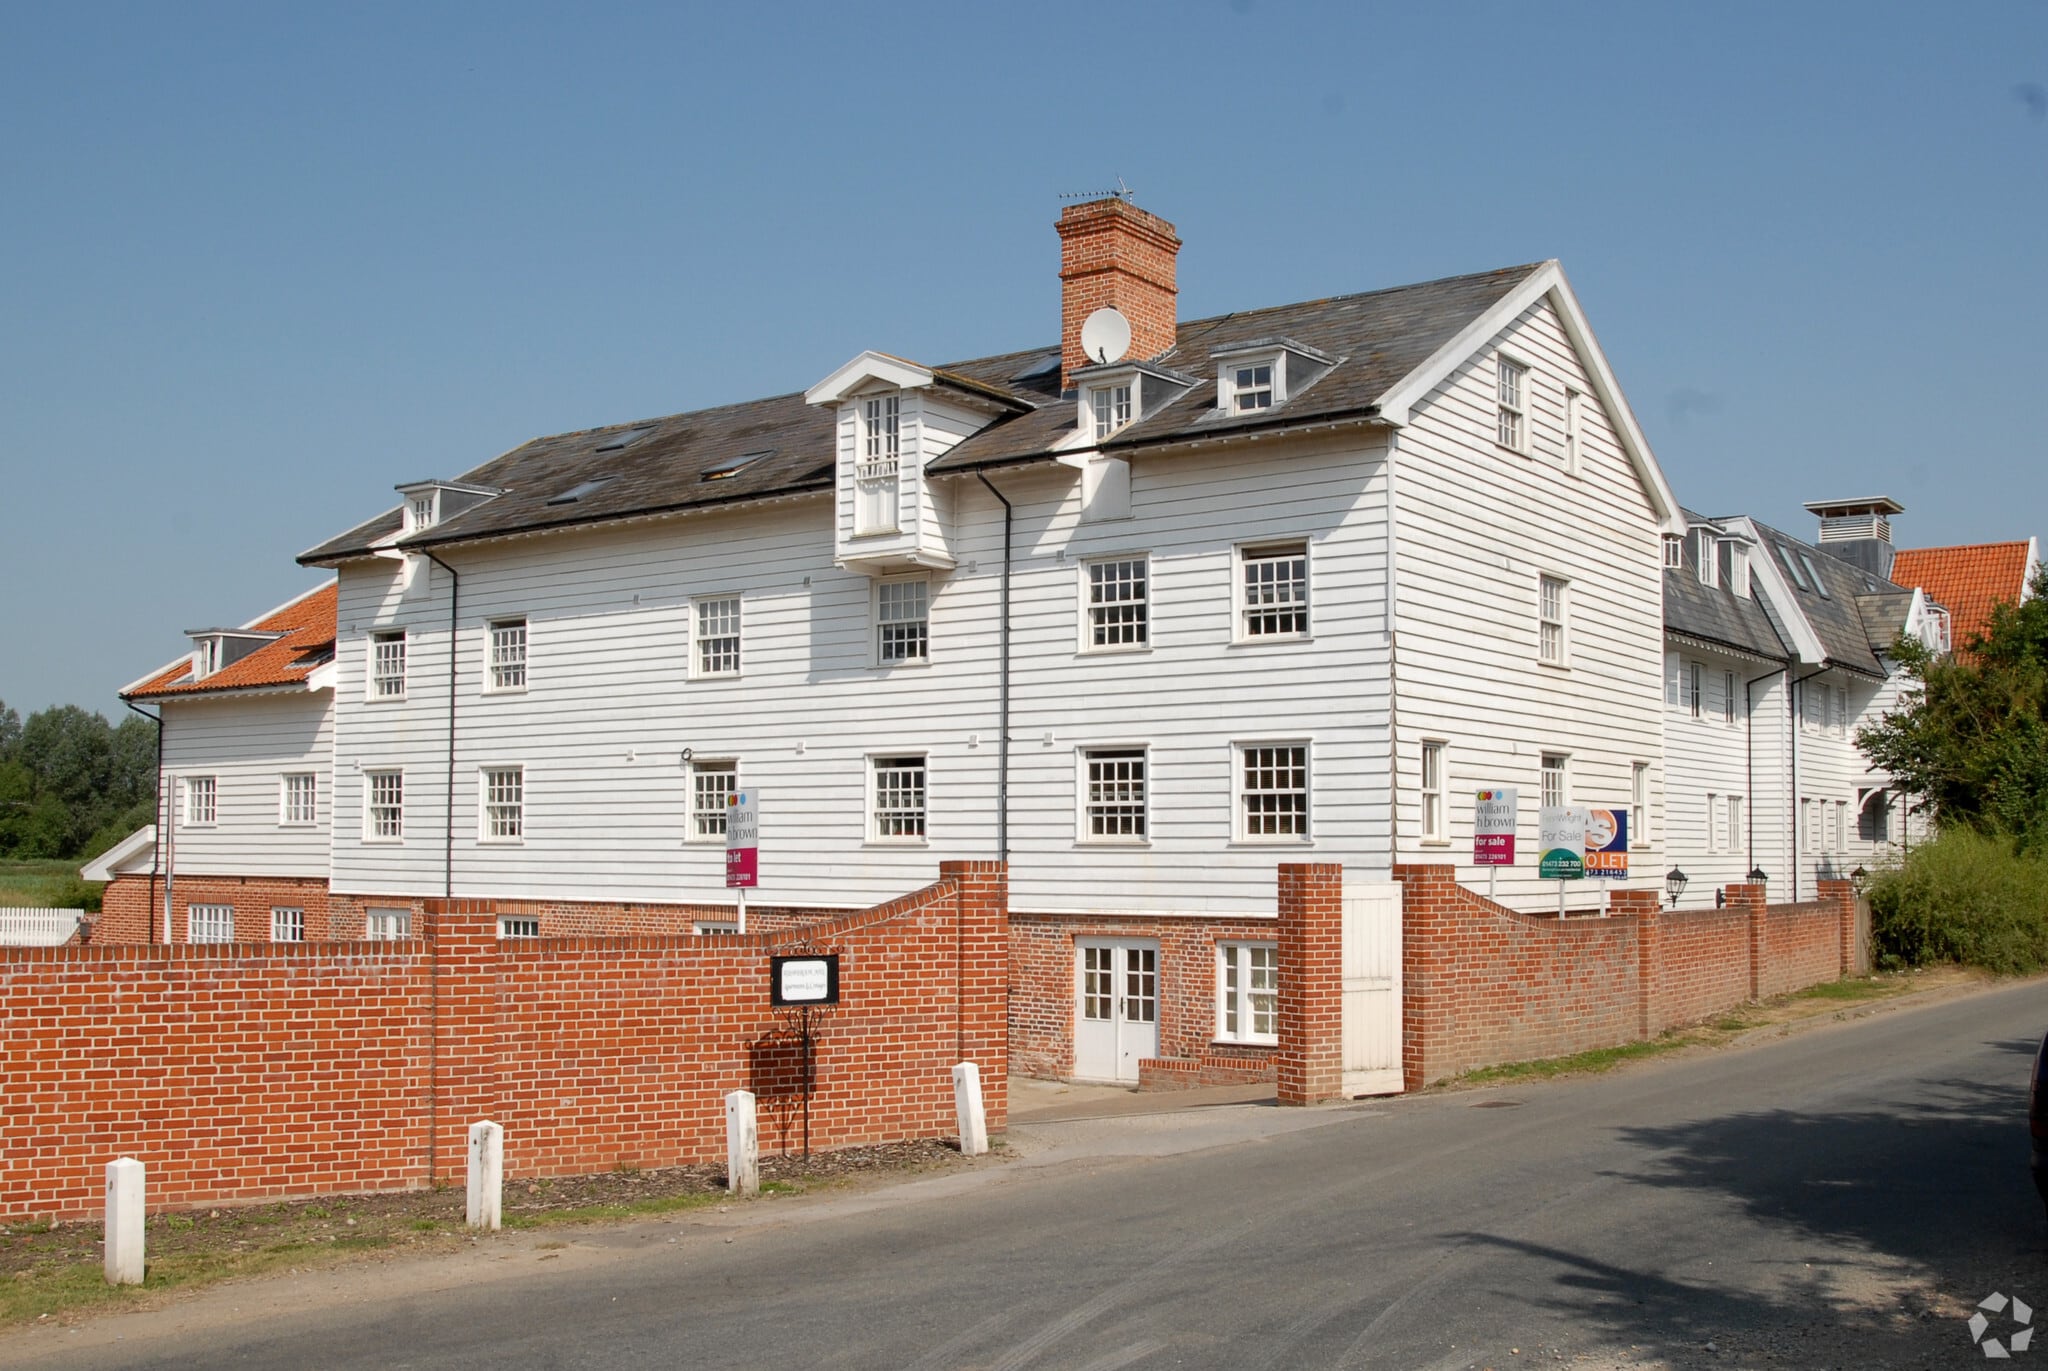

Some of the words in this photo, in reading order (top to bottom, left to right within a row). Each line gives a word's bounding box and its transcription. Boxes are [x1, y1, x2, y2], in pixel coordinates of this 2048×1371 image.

[1477, 802, 1509, 814] william
[727, 809, 752, 824] william
[1484, 816, 1515, 827] brown
[733, 826, 758, 840] brown
[1542, 831, 1555, 841] For
[1559, 831, 1581, 841] Sale
[1475, 836, 1486, 846] for
[1488, 836, 1505, 846] sale
[727, 853, 733, 863] to
[733, 851, 741, 863] let
[1601, 854, 1627, 868] LET
